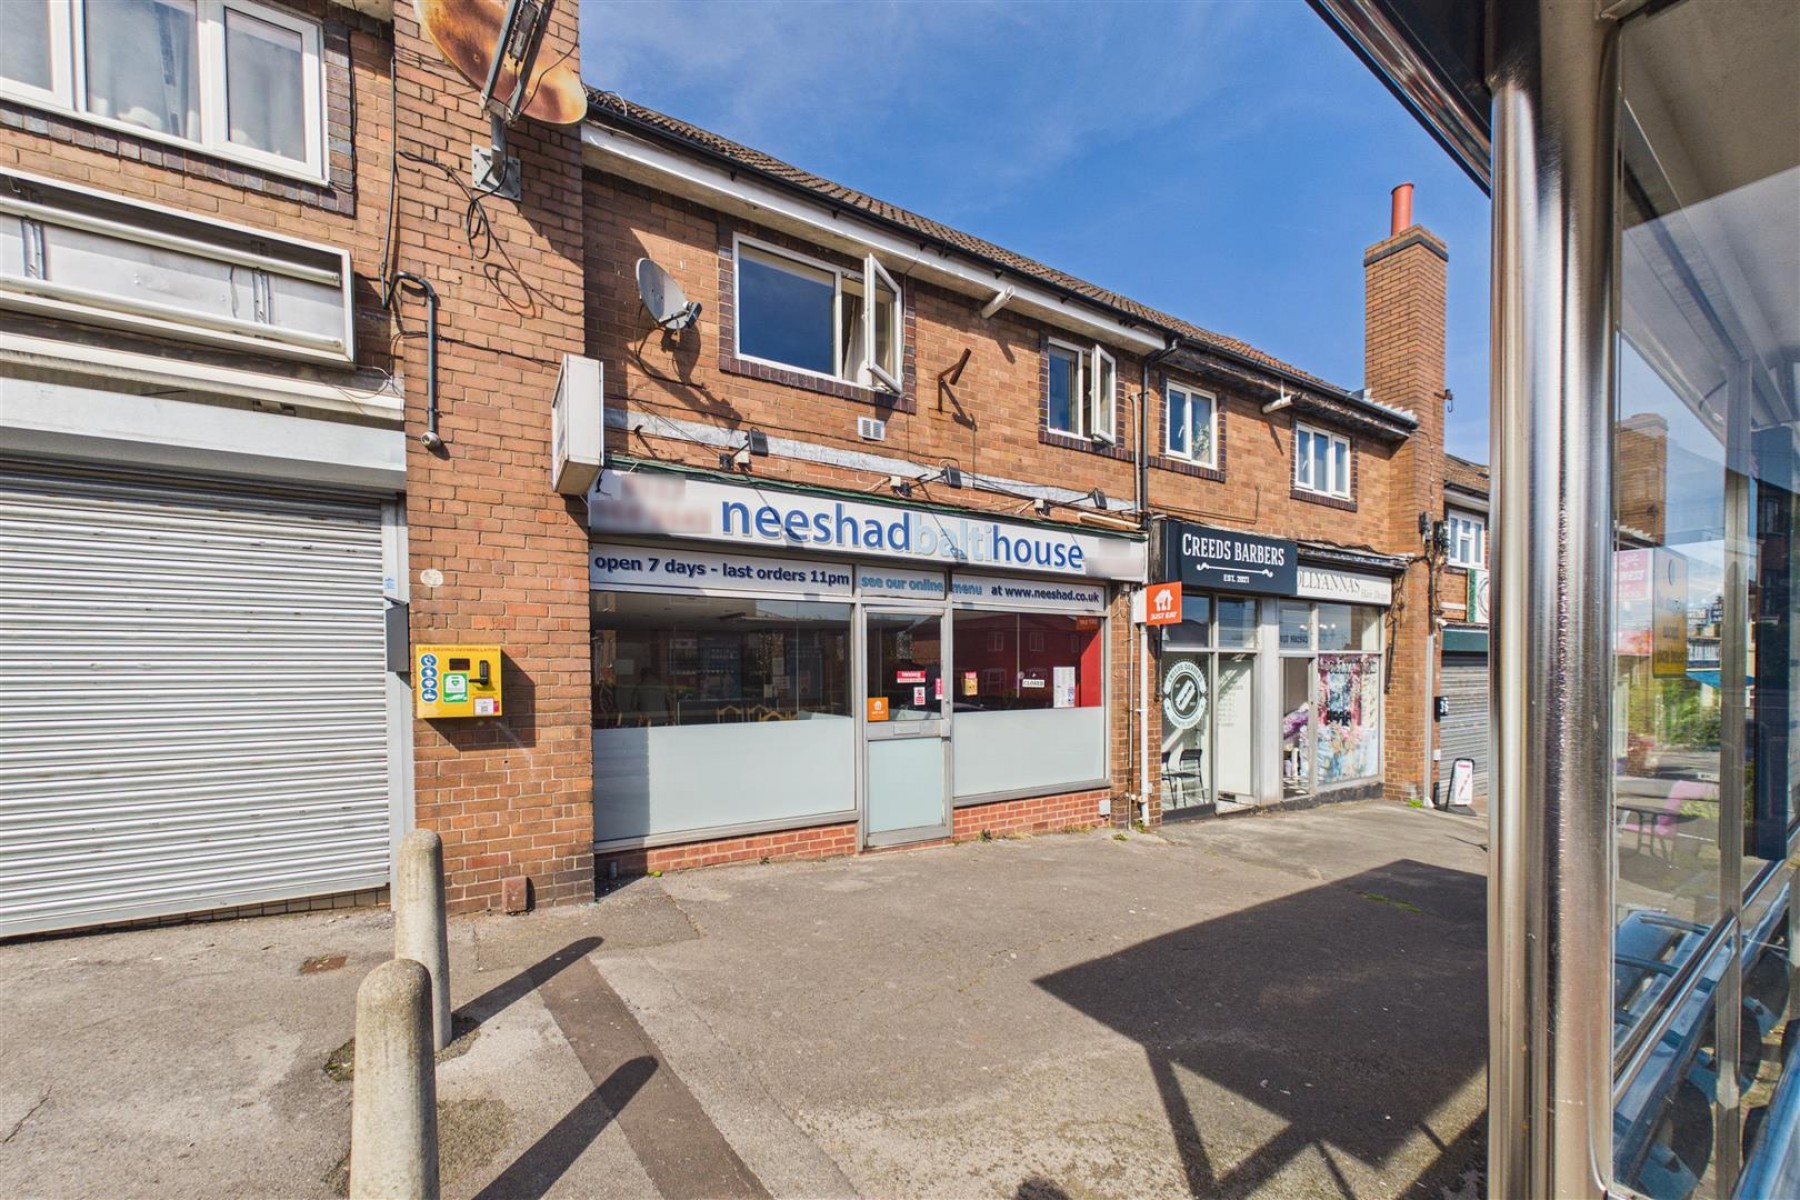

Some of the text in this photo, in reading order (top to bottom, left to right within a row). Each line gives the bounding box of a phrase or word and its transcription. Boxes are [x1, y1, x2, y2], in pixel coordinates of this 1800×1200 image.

[1182, 533, 1285, 566] CREEDS BARBERS
[594, 556, 643, 573] open
[648, 557, 660, 572] 7
[664, 559, 707, 578] days
[723, 563, 753, 579] last
[757, 567, 806, 582] orders
[810, 570, 850, 586] 11pm
[861, 576, 1100, 603] see our online menu at www.neeshad.co.uk
